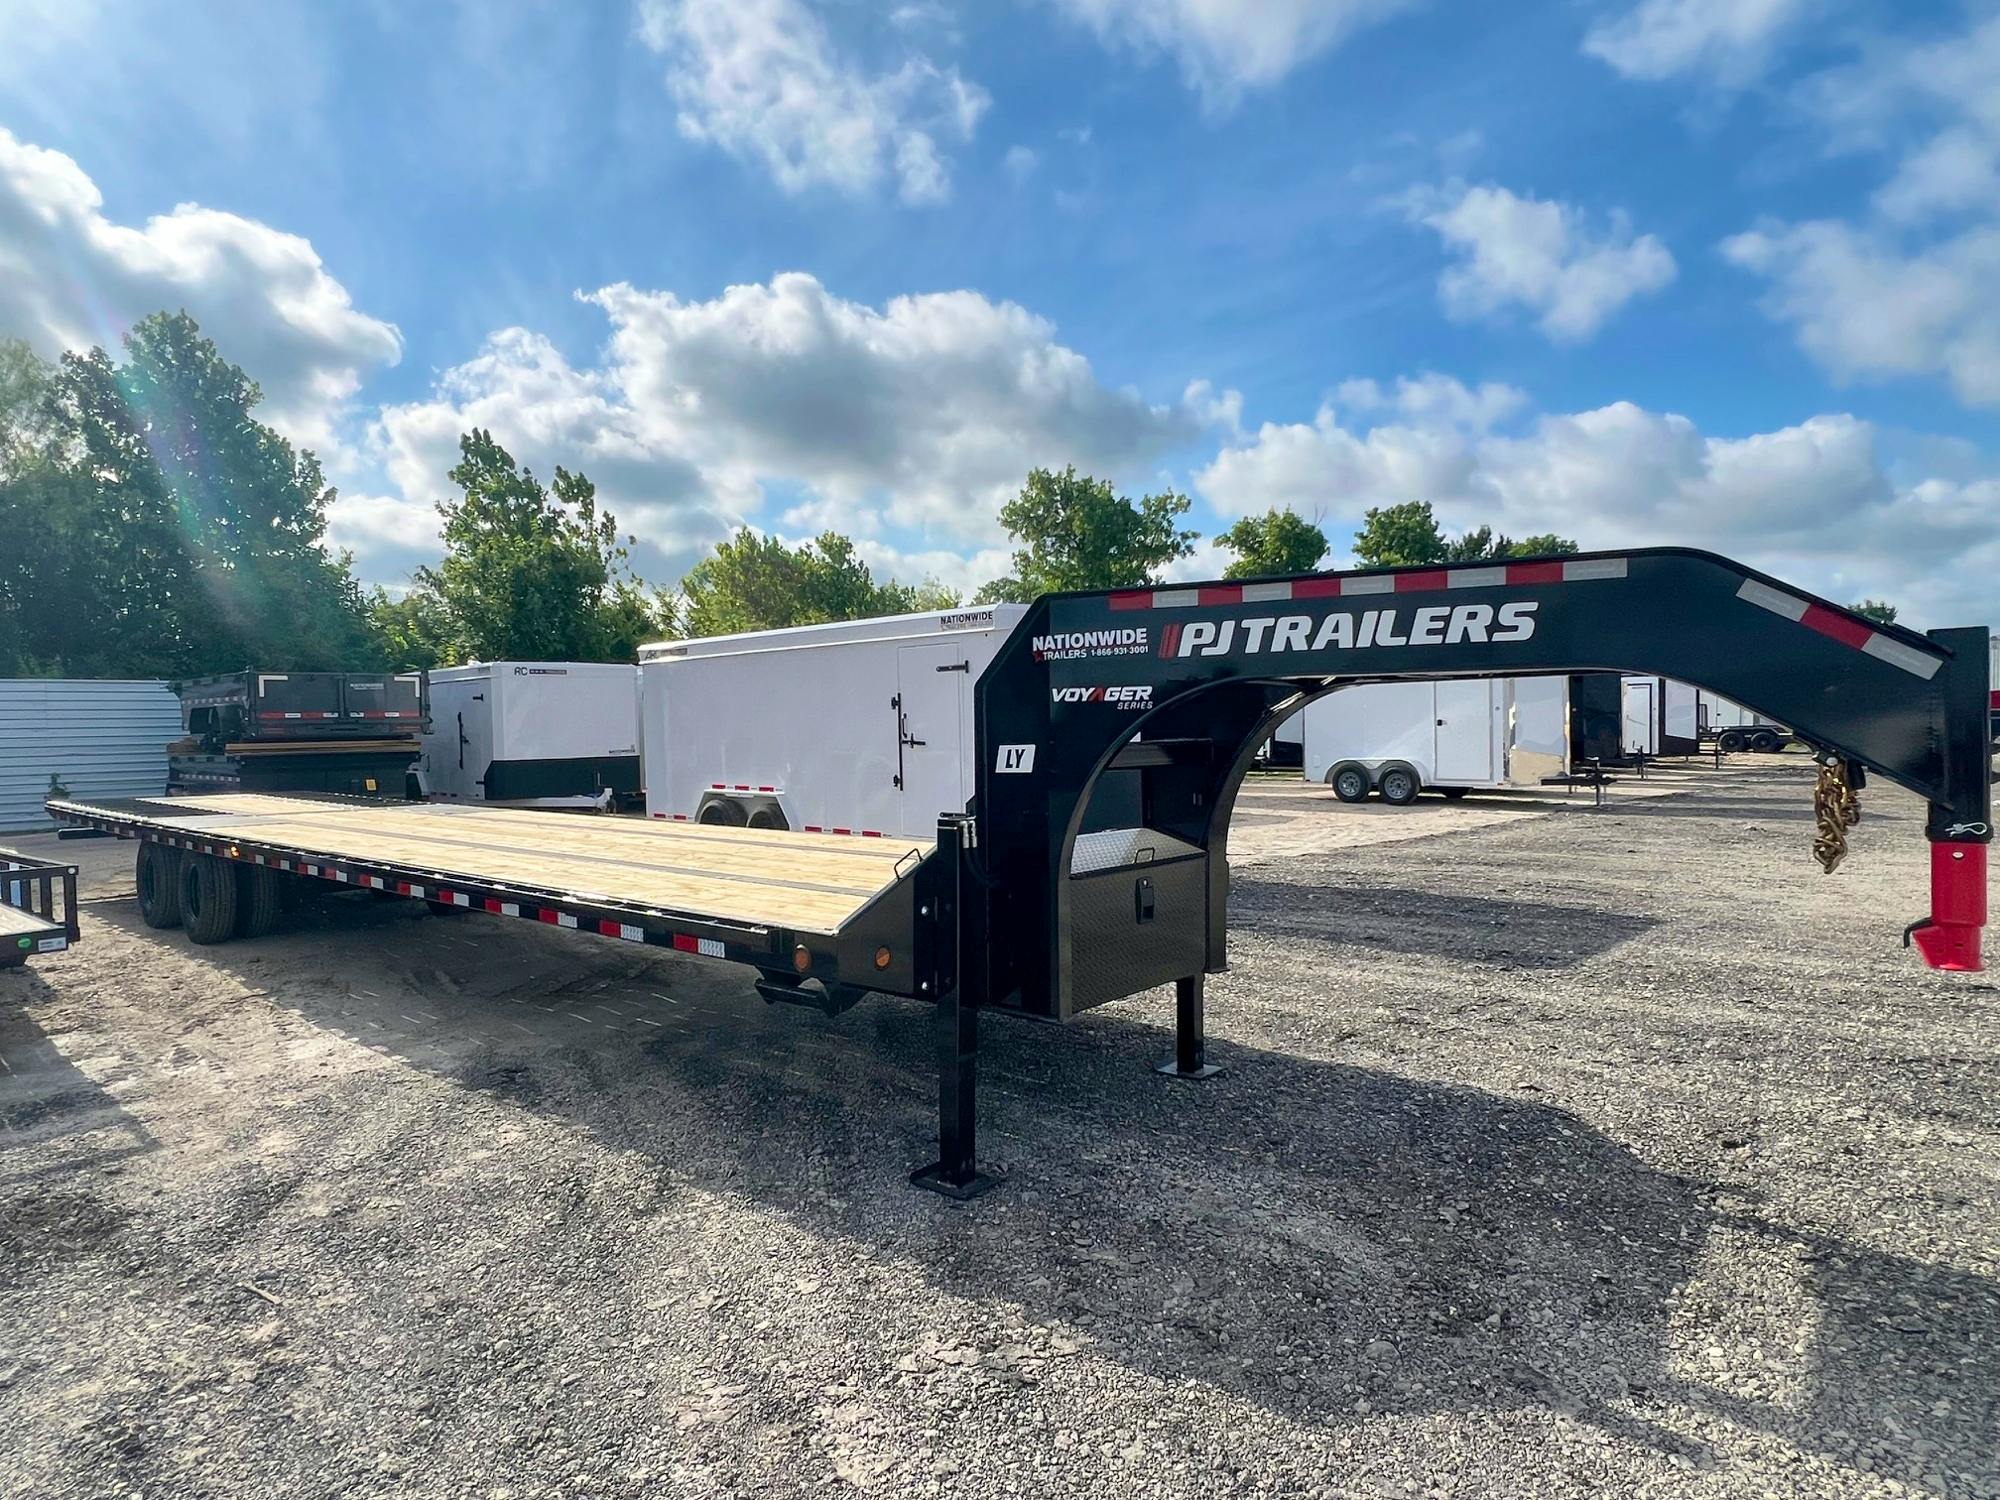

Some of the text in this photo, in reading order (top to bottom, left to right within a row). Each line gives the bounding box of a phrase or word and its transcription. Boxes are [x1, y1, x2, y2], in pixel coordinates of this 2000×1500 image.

[940, 611, 993, 625] NATIONWIDE
[1177, 601, 1539, 658] PJ TRAILERS
[1032, 627, 1148, 652] NATIONWIDE
[1043, 645, 1149, 661] TRAILERS 1-866-931-3001
[1051, 685, 1153, 703] VOYAGER
[1117, 700, 1153, 710] SERIES
[1005, 748, 1027, 769] LY
